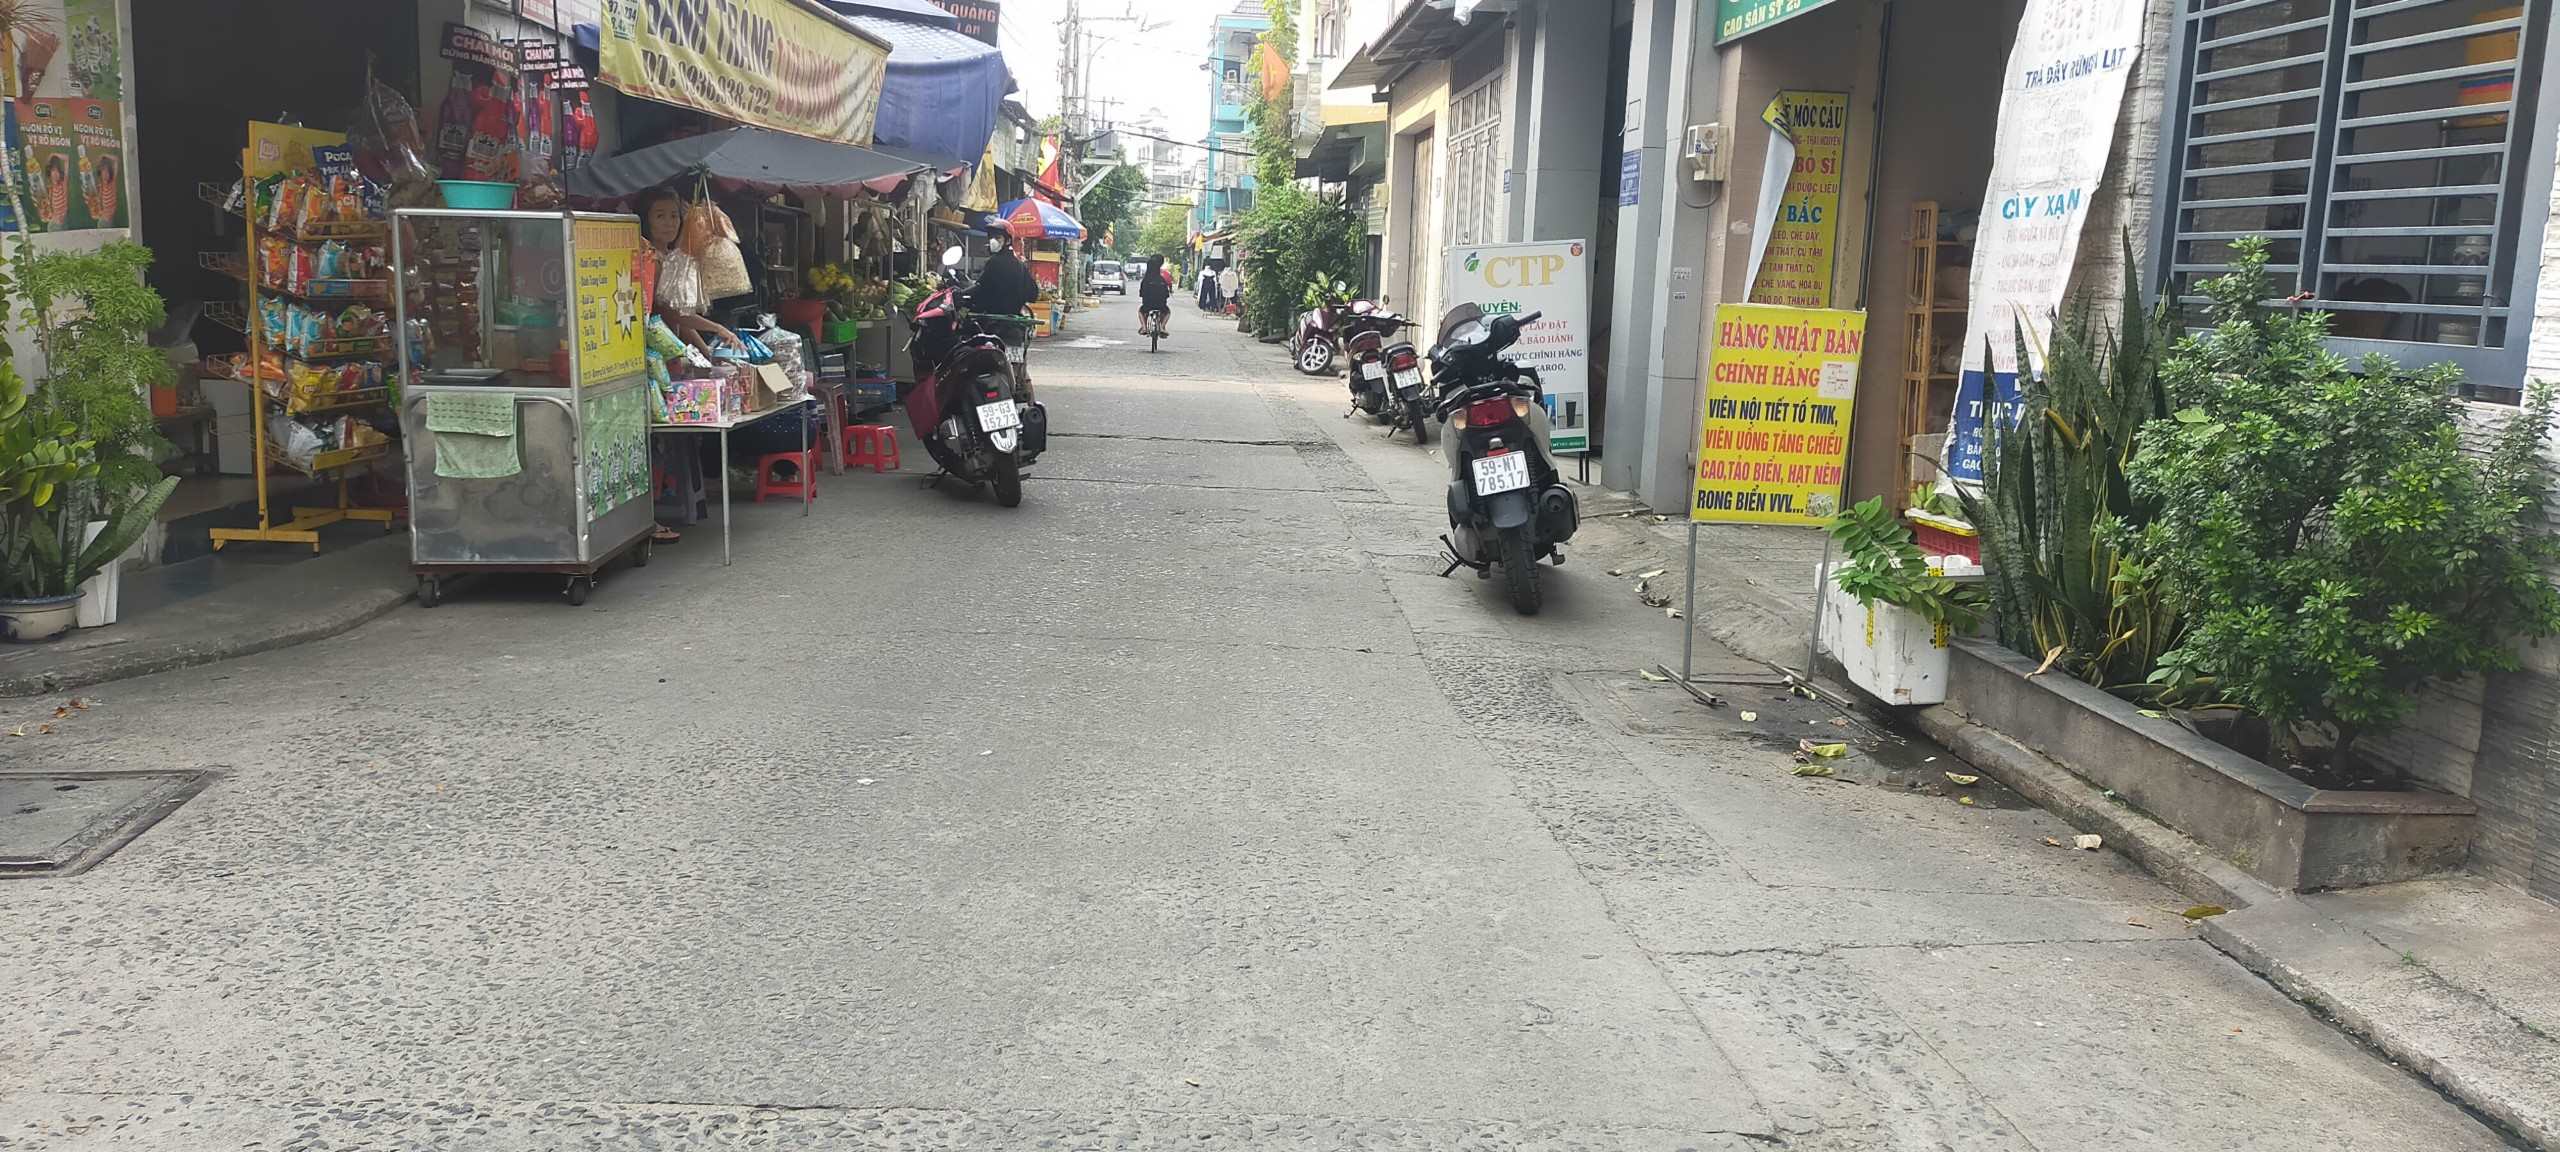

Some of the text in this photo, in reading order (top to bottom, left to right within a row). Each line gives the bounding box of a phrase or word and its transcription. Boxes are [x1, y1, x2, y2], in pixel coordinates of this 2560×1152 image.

[1723, 15, 1743, 37] CAO
[1786, 196, 1823, 223] BẮC
[1484, 254, 1566, 288] CTP
[1720, 315, 1862, 359] HÀNG NHẬT BẢN
[1714, 357, 1769, 385] CHÍNH
[1772, 361, 1820, 388] HÃNG
[981, 402, 1010, 418] 59-G3
[984, 413, 1017, 430] 152.73
[1709, 395, 1838, 428] VIÊN NỘI TIẾT TỐ TMK,
[1705, 426, 1734, 450] VIÊN
[1736, 424, 1769, 452] UỐNG
[1772, 430, 1805, 454] TĂNG
[1480, 455, 1517, 477] 59-N1
[1753, 455, 1784, 485] BIỂN,
[1787, 463, 1812, 489] HẠT
[1813, 462, 1842, 486] NÊM
[1479, 470, 1524, 495] 785.17
[1696, 489, 1733, 510] RONG
[1735, 484, 1767, 512] BIỂN
